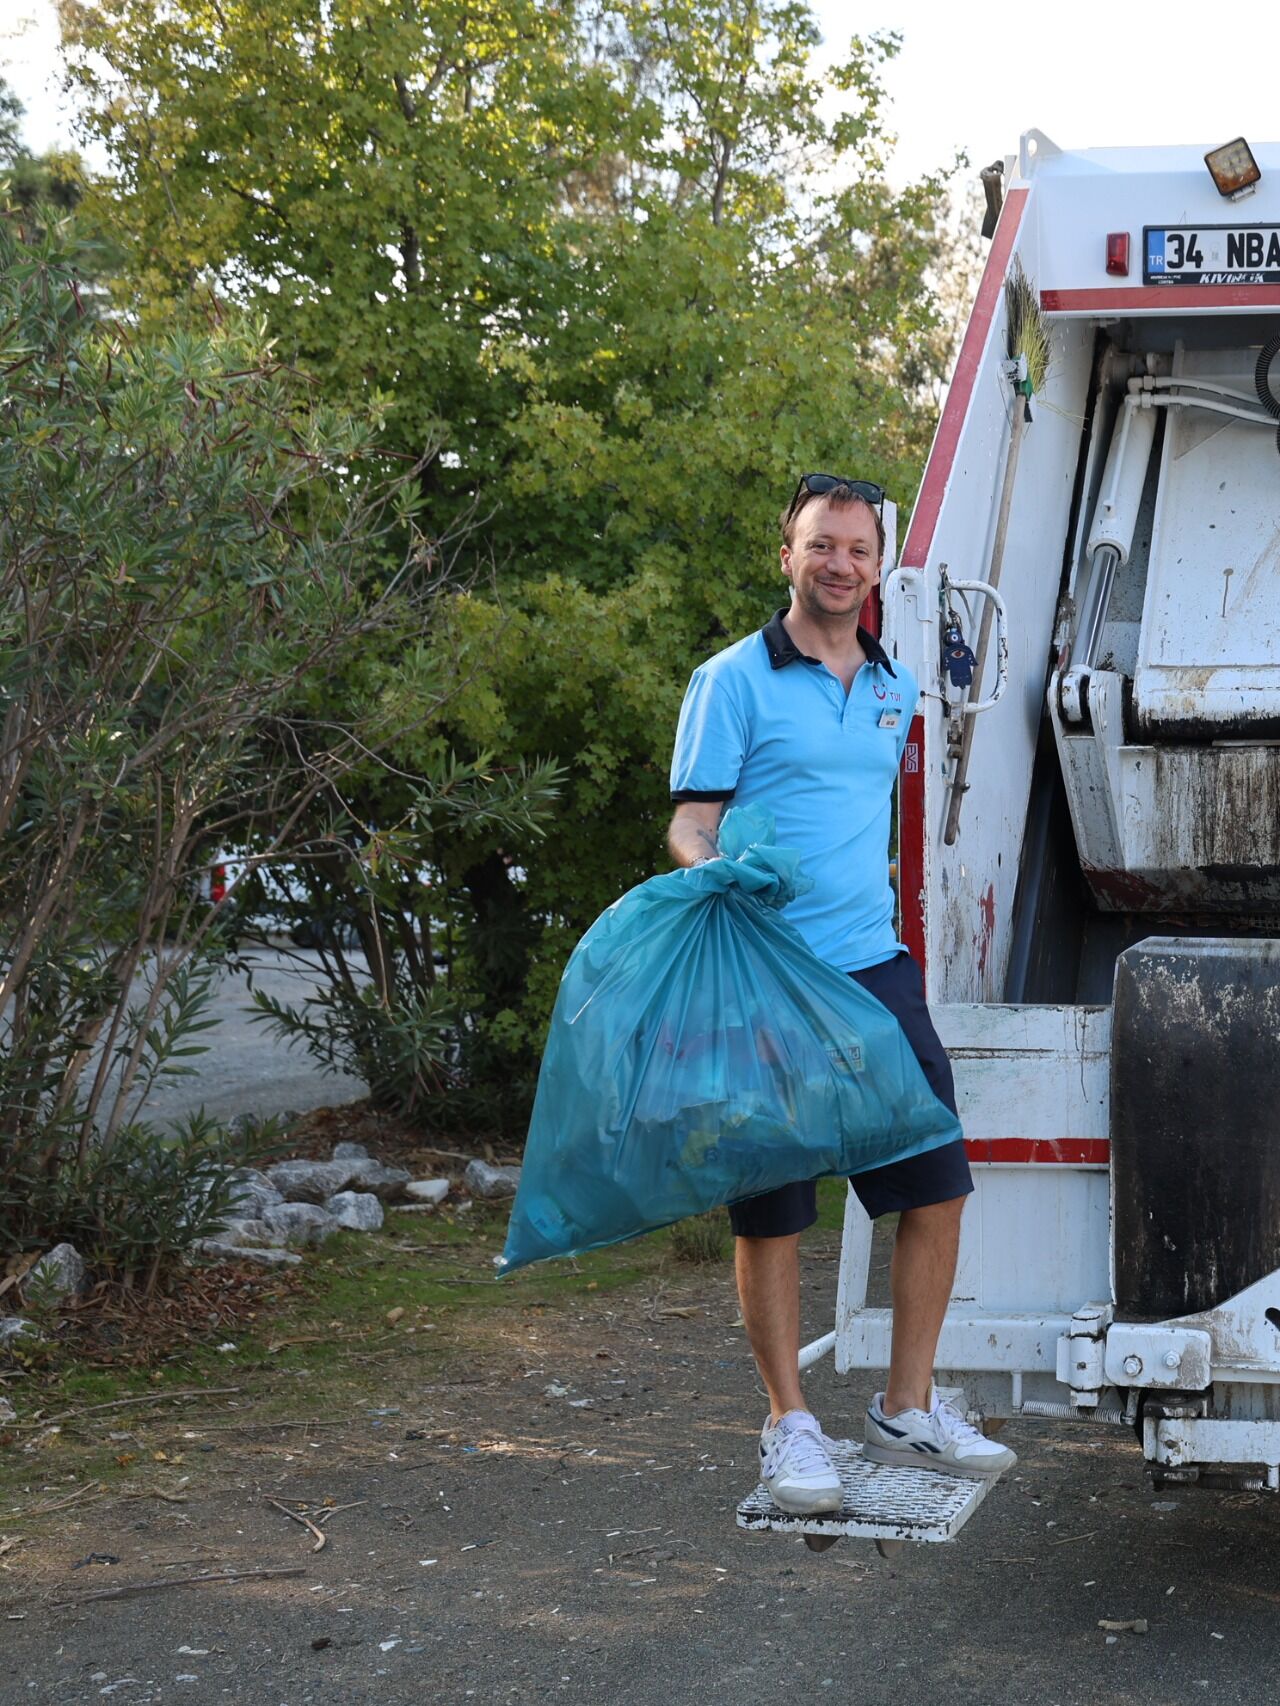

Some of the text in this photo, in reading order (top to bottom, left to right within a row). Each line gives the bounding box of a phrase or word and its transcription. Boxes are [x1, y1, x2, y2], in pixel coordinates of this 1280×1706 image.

[1166, 234, 1203, 269] 34
[1149, 256, 1163, 266] TR
[890, 692, 901, 702] TUI
